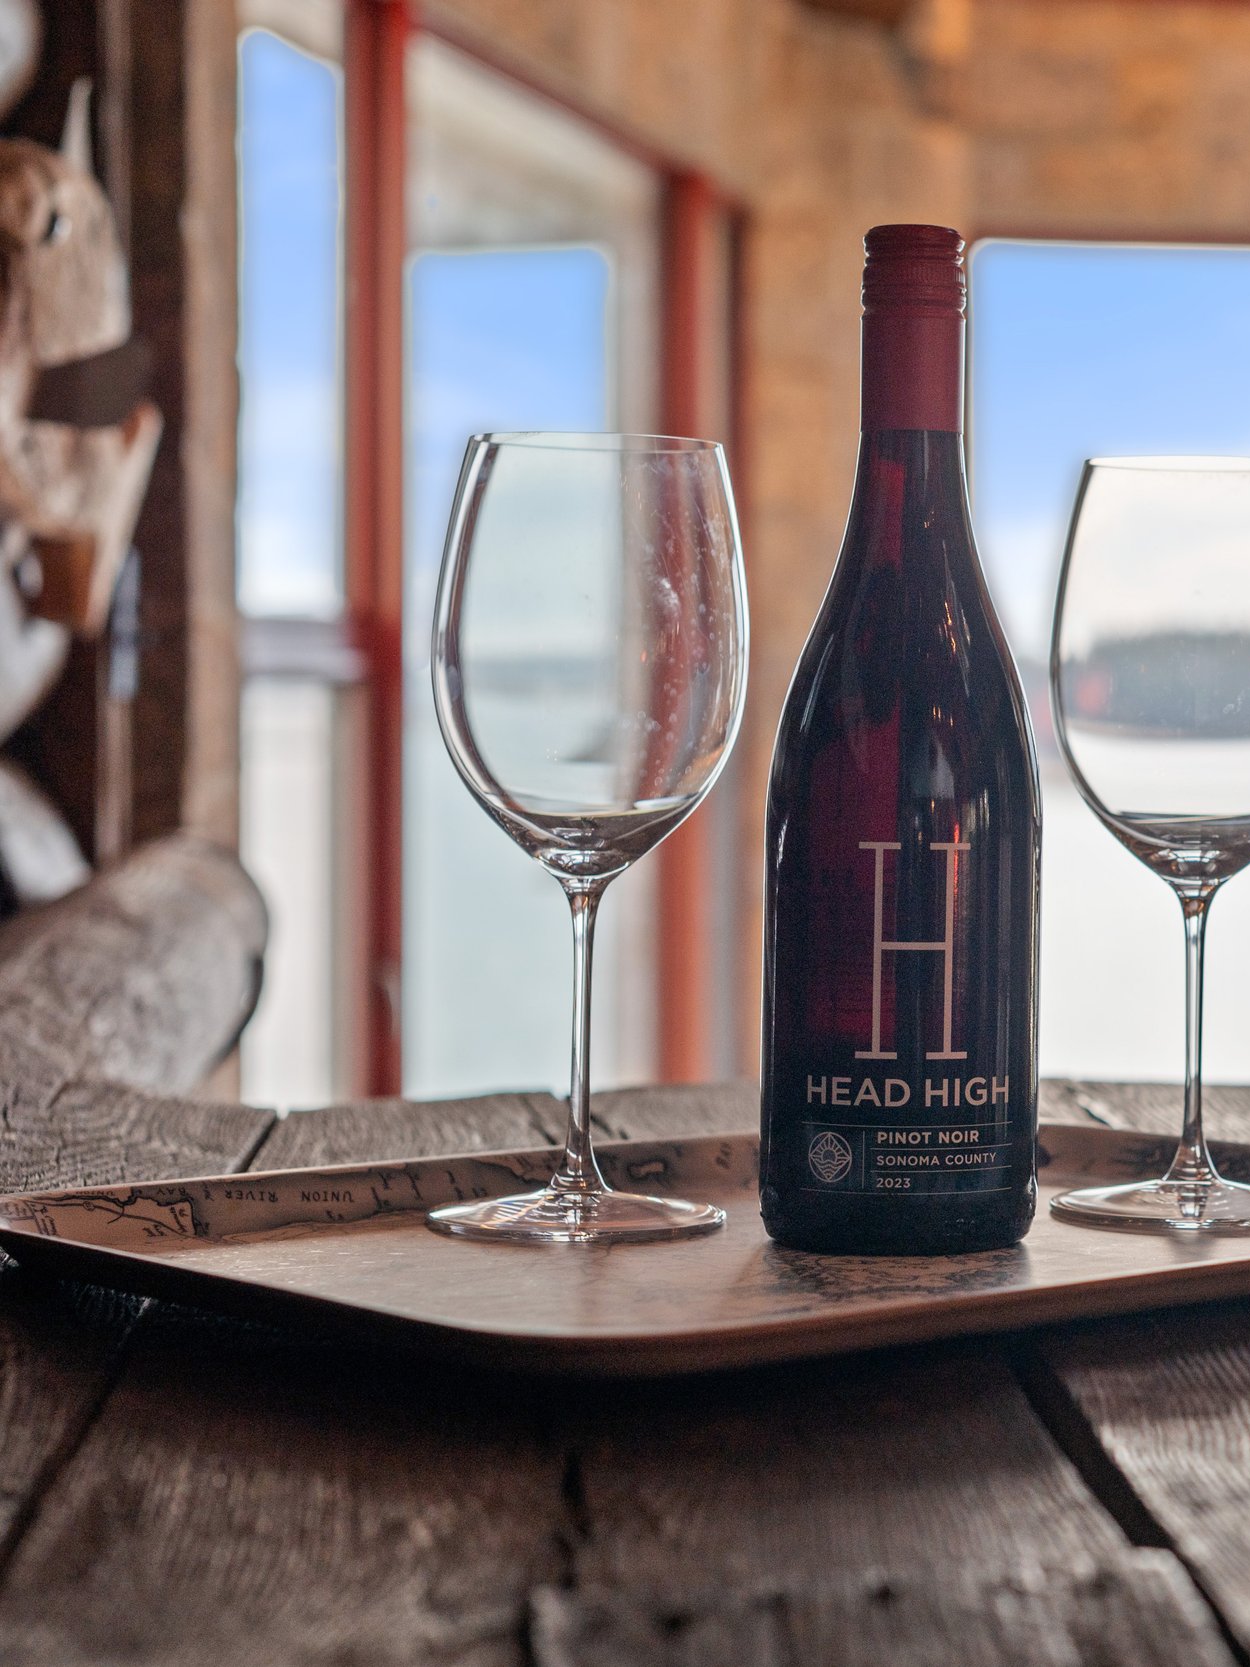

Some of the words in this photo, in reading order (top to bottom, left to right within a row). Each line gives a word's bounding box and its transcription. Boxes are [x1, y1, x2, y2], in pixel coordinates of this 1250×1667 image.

[854, 841, 972, 1060] H
[806, 1074, 911, 1107] HEAD
[924, 1075, 1010, 1107] HIGH
[877, 1131, 932, 1145] PINOT
[938, 1130, 979, 1144] NOIR
[876, 1154, 940, 1167] SONOMA
[945, 1152, 997, 1166] COUNTY
[876, 1177, 911, 1189] 2023
[224, 1189, 279, 1203] RIVER
[301, 1190, 355, 1203] UNION
